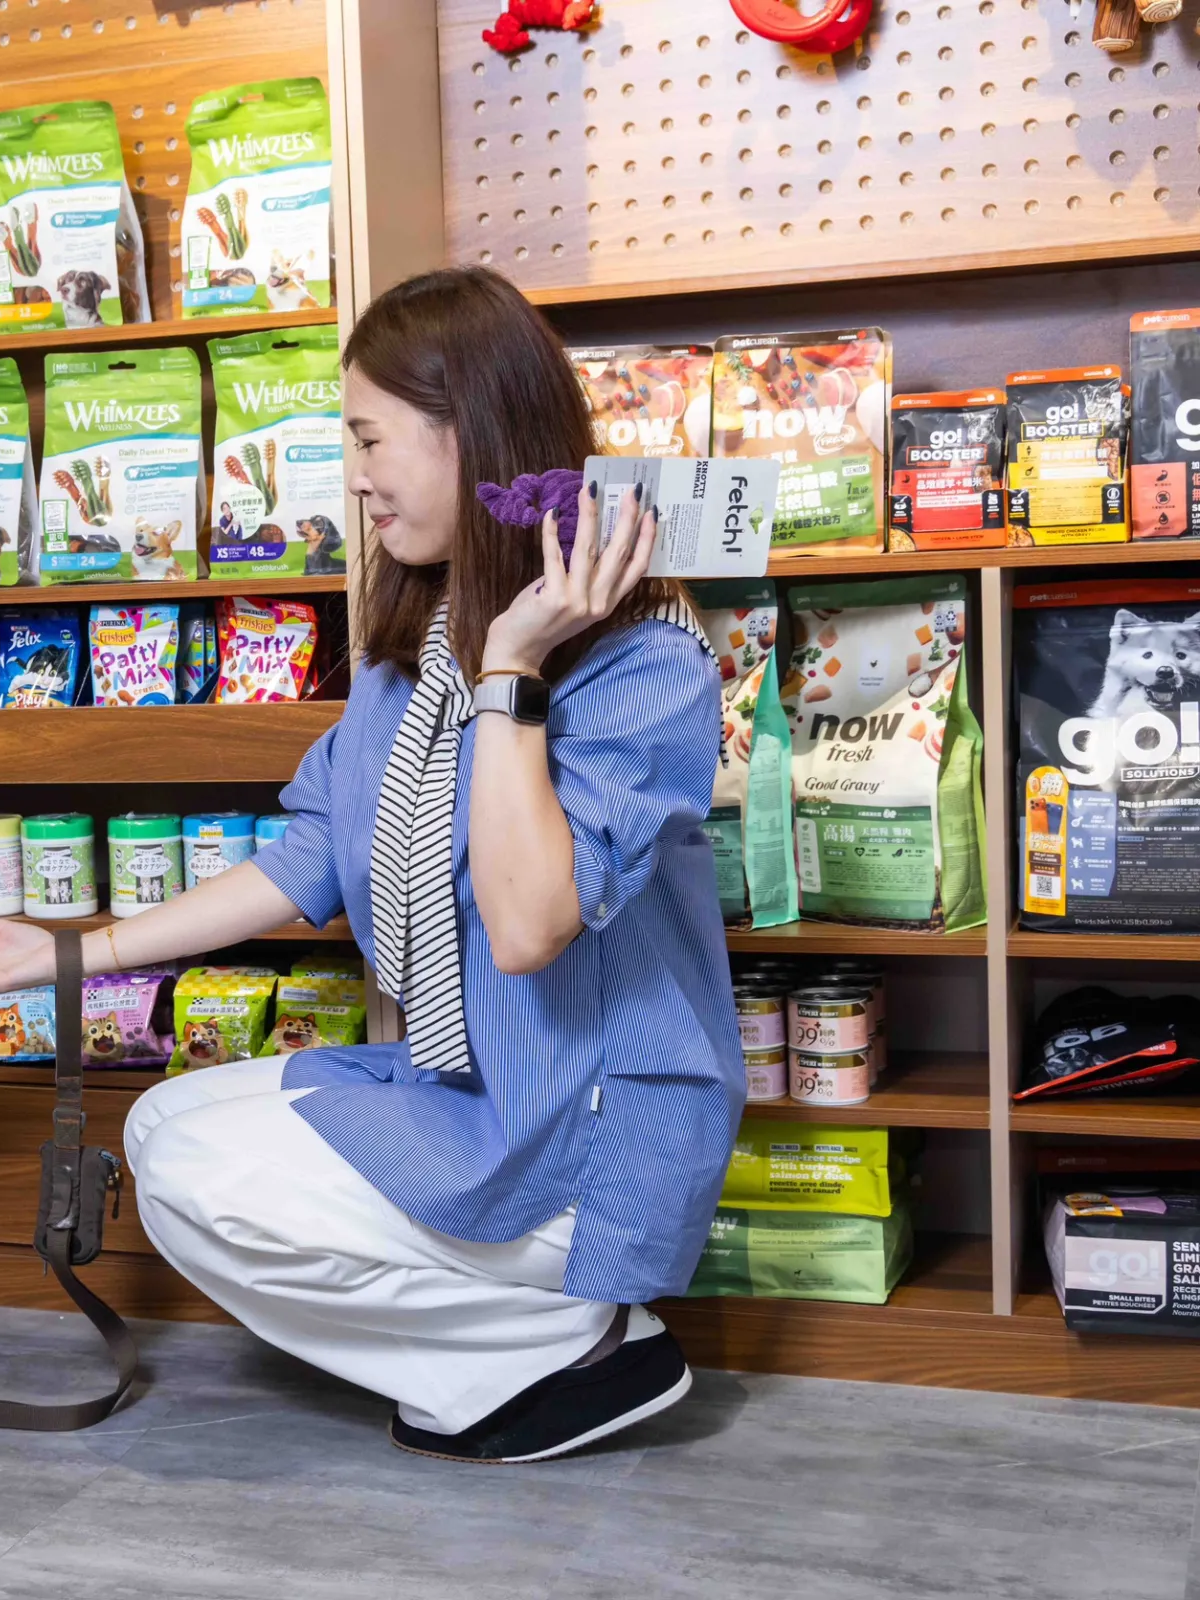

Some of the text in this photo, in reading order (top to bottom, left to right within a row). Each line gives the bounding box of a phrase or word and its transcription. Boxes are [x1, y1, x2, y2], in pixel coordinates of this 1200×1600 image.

[732, 336, 778, 348] petcurean
[1046, 402, 1079, 424] go!
[743, 405, 847, 439] now
[1026, 422, 1099, 438] BOOSTER
[930, 428, 962, 449] go!
[910, 448, 984, 462] BOOSTER
[845, 466, 867, 475] SENIOR
[692, 461, 701, 499] ANIMALS
[699, 460, 708, 499] KNOTTY
[216, 547, 229, 559] XS
[250, 546, 264, 557] 48
[81, 556, 95, 566] 24
[240, 615, 274, 632] Friskies
[8, 631, 43, 652] felix
[99, 631, 134, 643] Friskies
[236, 634, 296, 656] Party
[100, 639, 158, 674] Party
[238, 655, 287, 674] Mix
[113, 663, 157, 690] Mix
[133, 682, 165, 695] crunch
[809, 712, 905, 743] now
[1058, 701, 1200, 786] go!
[827, 744, 873, 763] fresh
[1126, 767, 1195, 779] SOLUTIONS
[804, 776, 881, 795] Good Gravy
[823, 824, 856, 843] 高湯
[770, 1153, 861, 1165] grain-free recipe
[770, 1162, 841, 1174] with turkey,
[770, 1171, 809, 1180] salmon
[824, 1171, 852, 1181] duck
[819, 1181, 845, 1189] dinde,
[1089, 1247, 1160, 1287] go!
[1092, 1299, 1156, 1309] PETITES BOUCHÉES
[1109, 1294, 1133, 1302] SMALL
[1173, 1292, 1180, 1300] À
